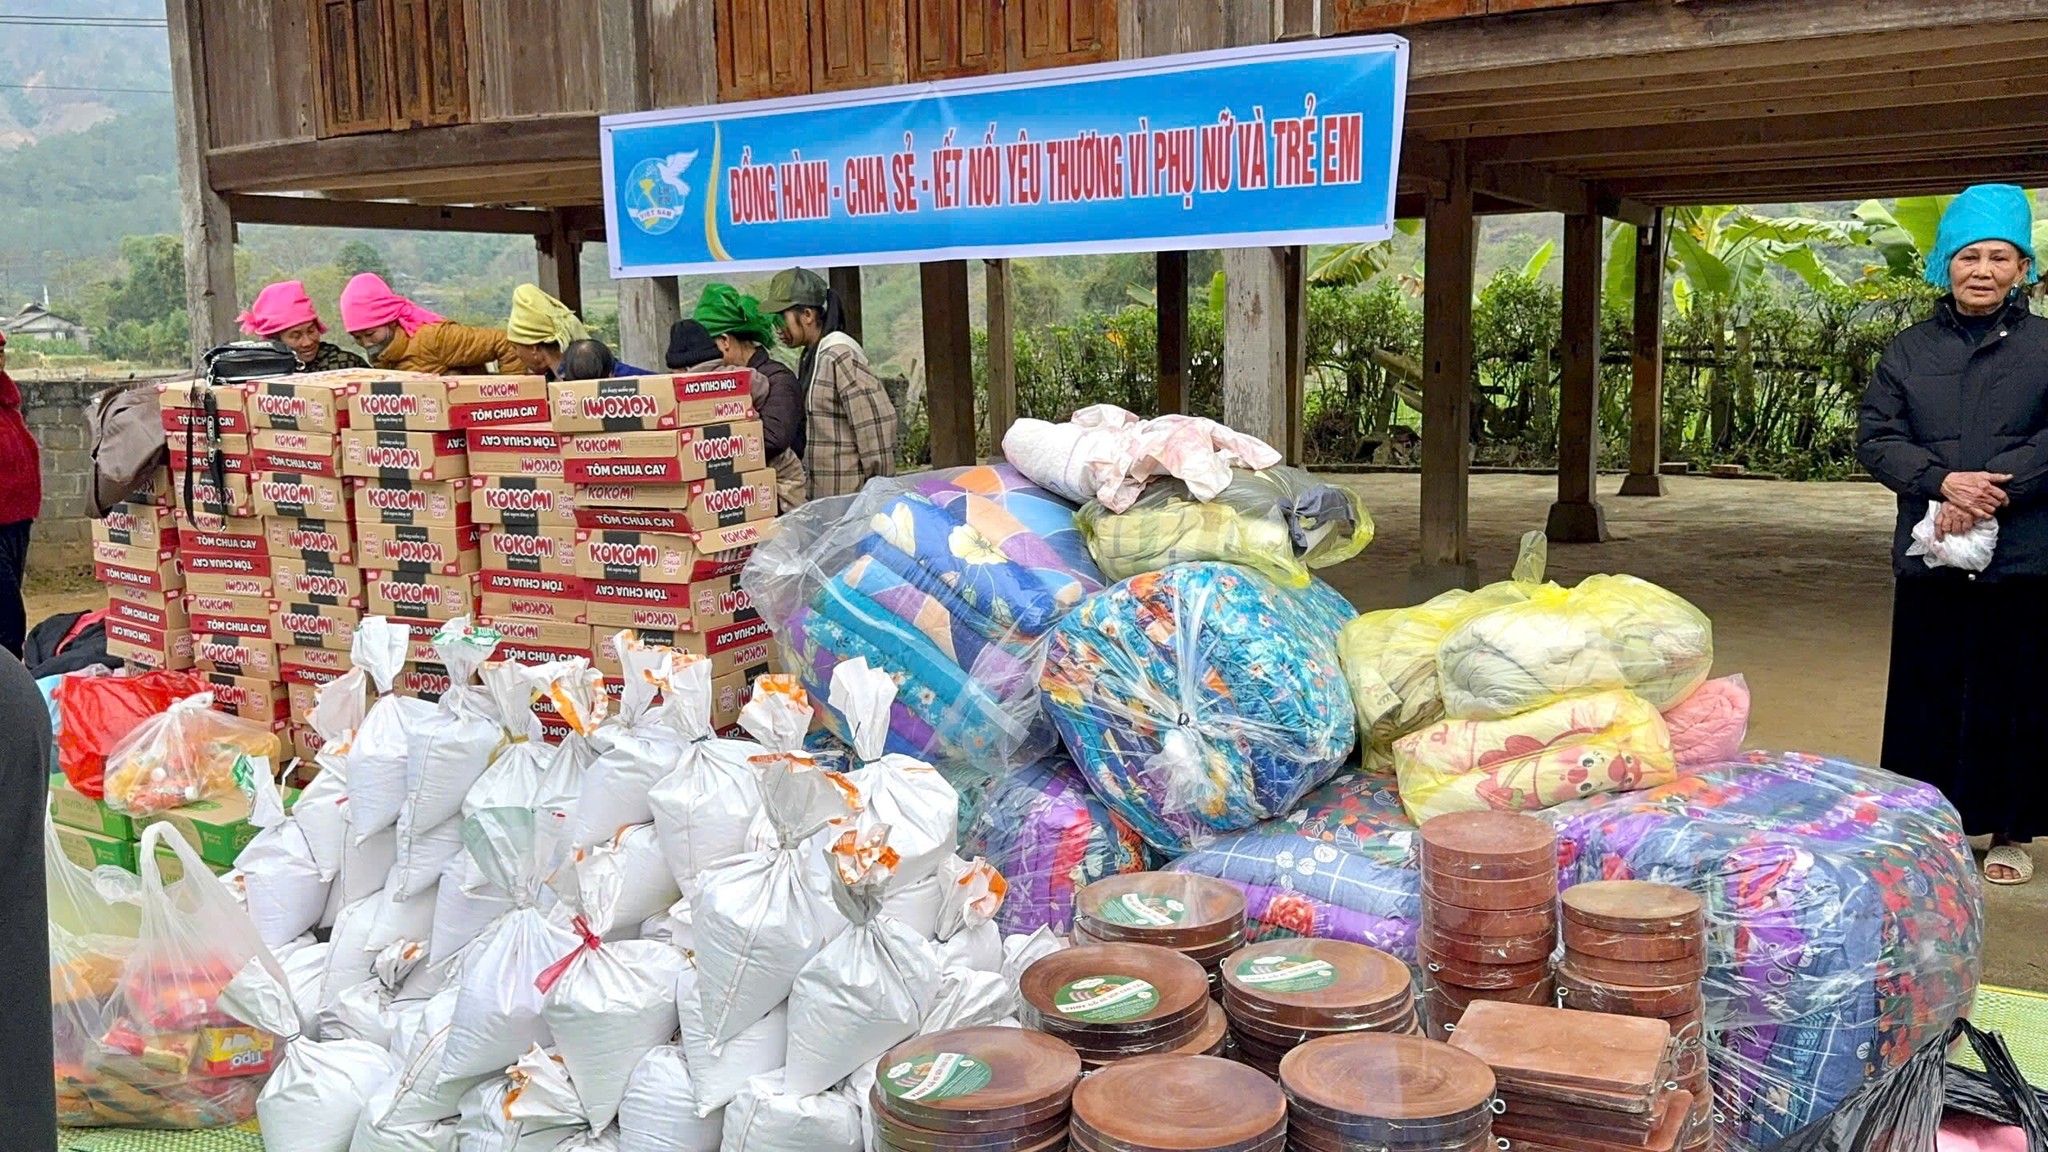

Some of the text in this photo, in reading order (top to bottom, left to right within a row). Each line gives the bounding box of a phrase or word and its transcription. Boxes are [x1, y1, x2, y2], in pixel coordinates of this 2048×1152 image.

[730, 94, 1362, 223] ĐỒNG HÀNH - CHIA SẺ - KẾT NỐI YÊU THƯƠNG VÌ PHỤ NỮ VÀ TRẺ EM
[480, 383, 519, 397] KOKOMI
[685, 379, 736, 394] TÔM CHUA CAY
[257, 395, 306, 416] KOKOMI
[360, 395, 418, 416] KOKOMI
[583, 396, 658, 418] KOKOMI
[714, 402, 744, 417] KOKOMI
[471, 406, 538, 421] TÔM CHUA CAY
[219, 417, 235, 426] CAY
[275, 435, 307, 449] KOKOMI
[446, 438, 467, 449] CAY
[481, 435, 557, 450] TÔM CHUA CAY
[575, 438, 623, 453] KOKOMI
[694, 436, 745, 462] KOKOMI
[225, 459, 241, 469] CAY
[267, 456, 323, 470] TÔM CHUA CAY
[366, 446, 421, 468] KOKOMI
[586, 463, 667, 476] TÔM CHUA CAY
[262, 483, 314, 504] KOKOMI
[367, 489, 426, 511] KOKOMI
[485, 489, 552, 512] KOKOMI
[587, 486, 634, 500] KOKOMI
[704, 487, 756, 513] KOKOMI
[596, 513, 675, 528] TÔM CHUA CAY
[197, 535, 256, 549] TÔM CHUA CAY
[289, 531, 338, 552] KOKOMI
[720, 528, 759, 544] KOKOMI
[384, 540, 443, 562] KOKOMI
[493, 534, 553, 558] KOKOMI
[589, 544, 658, 567] KOKOMI
[192, 558, 252, 572] TÔM CHUA CAY
[226, 580, 261, 593] KOKOMI
[296, 575, 348, 596] KOKOMI
[492, 575, 564, 592] TÔM CHUA CAY
[380, 583, 440, 605] KOKOMI
[595, 584, 668, 602] TÔM CHUA CAY
[199, 599, 233, 611] KOKOMI
[511, 600, 555, 615] KOKOMI
[281, 613, 333, 635] KOKOMI
[633, 611, 677, 626] KOKOMI
[207, 619, 267, 634] TÔM CHUA CAY
[494, 623, 538, 638] KOKOMI
[717, 626, 756, 646] CHUA CAY
[201, 644, 249, 664] KOKOMI
[304, 650, 337, 664] KOKOMI
[503, 647, 557, 662] TÔM CHUA
[734, 644, 768, 666] KOKOMI
[297, 669, 316, 680] TÔM
[404, 672, 452, 694] OKOMI
